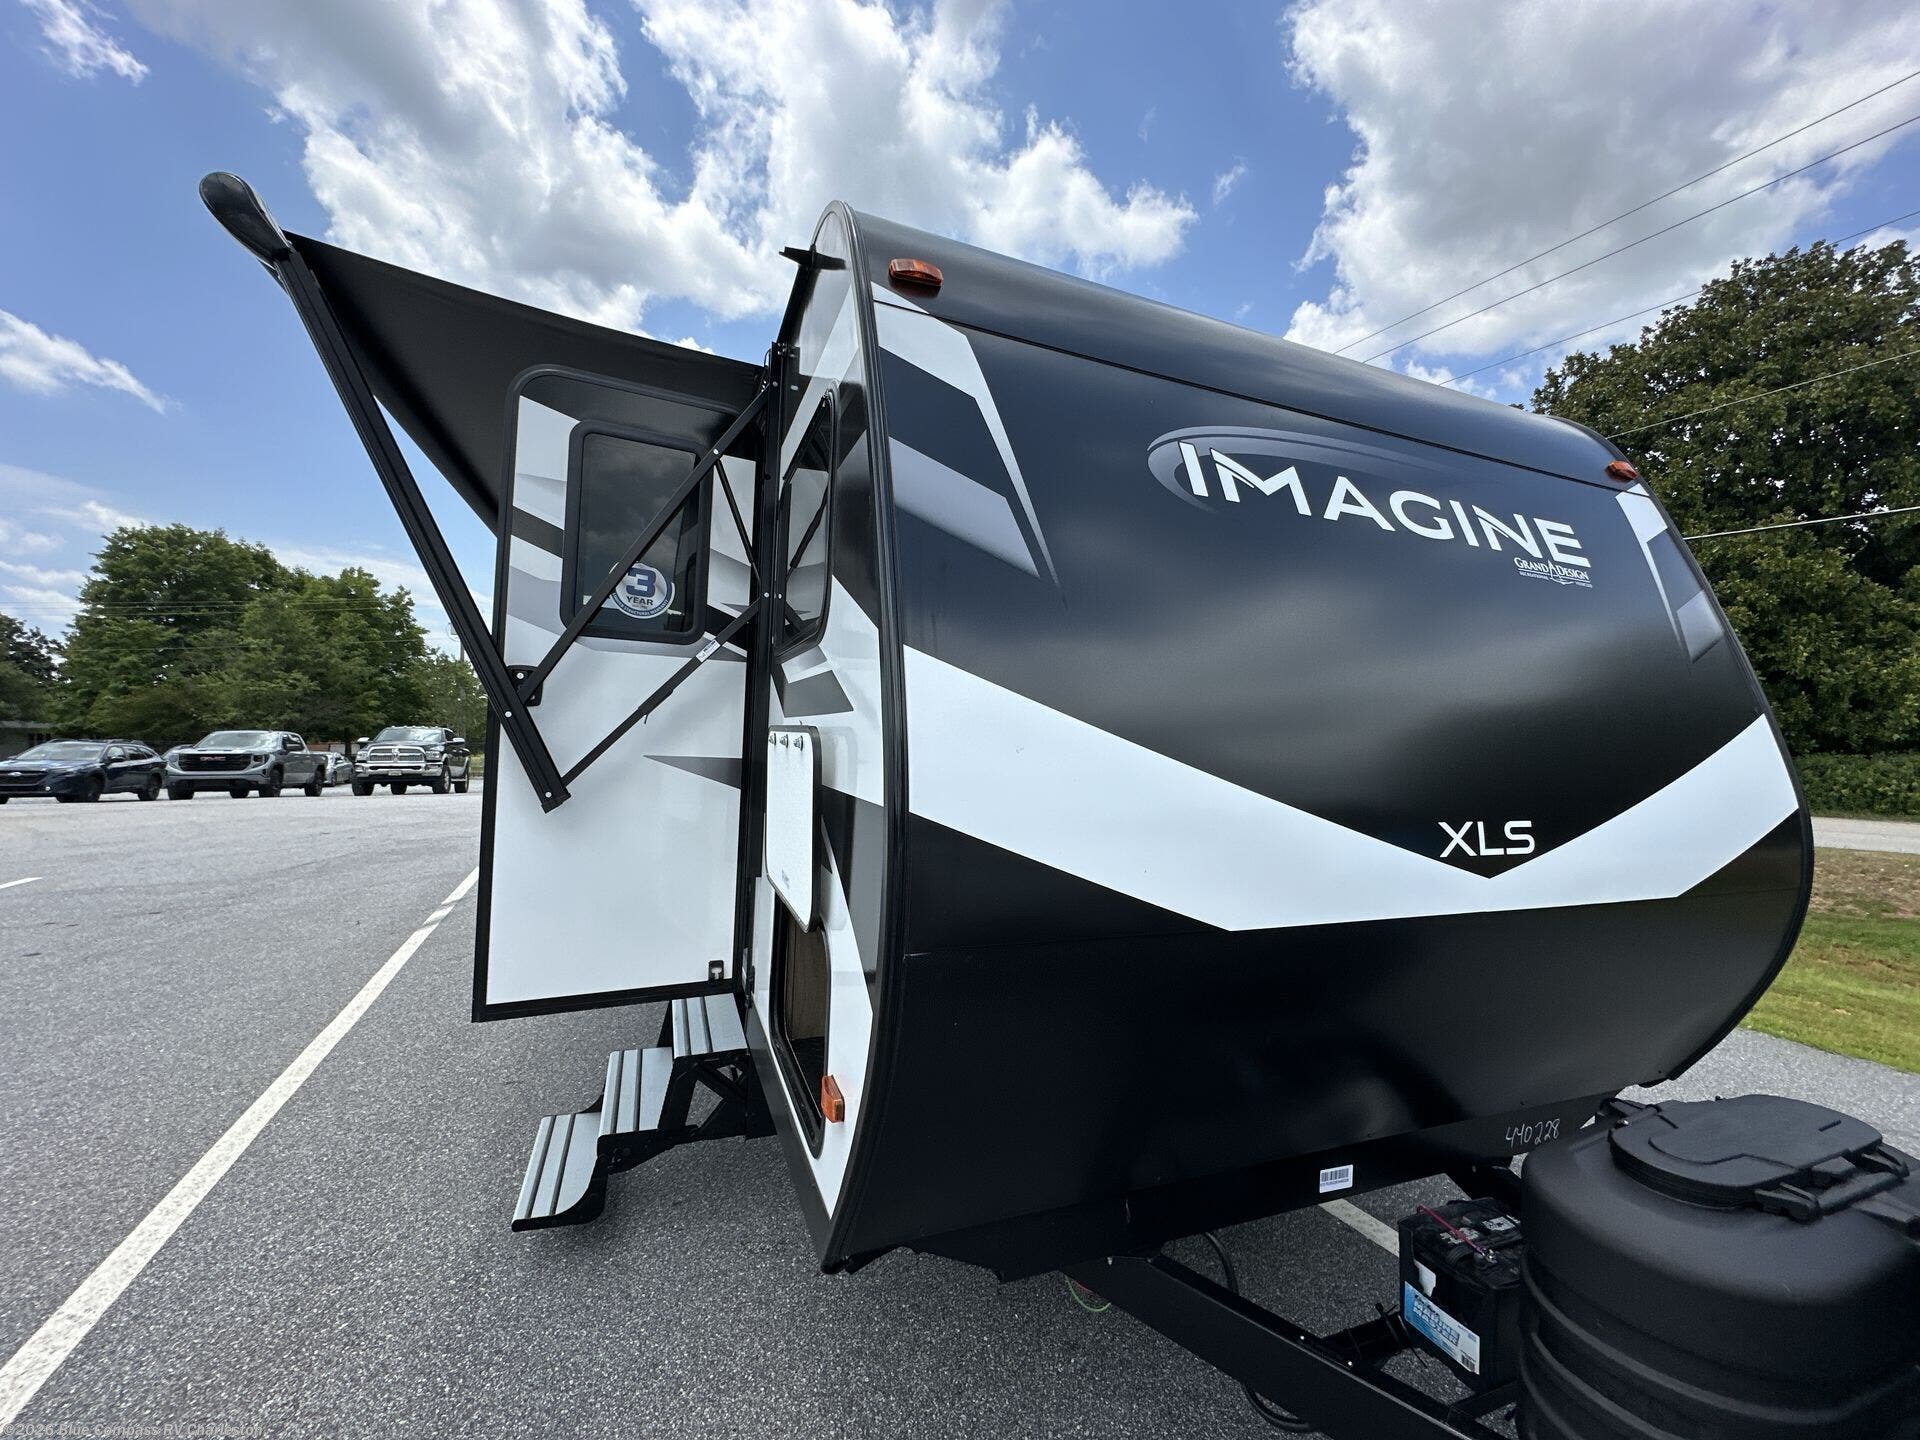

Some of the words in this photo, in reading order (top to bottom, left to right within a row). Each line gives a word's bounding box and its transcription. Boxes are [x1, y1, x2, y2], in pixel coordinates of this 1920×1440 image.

[1178, 440, 1592, 568] IMAGINE
[626, 568, 656, 598] 3
[1514, 557, 1549, 573] GRAND
[1558, 565, 1590, 581] DESIGN
[626, 594, 654, 606] YEAR
[1438, 820, 1536, 858] XLS
[1505, 1118, 1560, 1148] 440228
